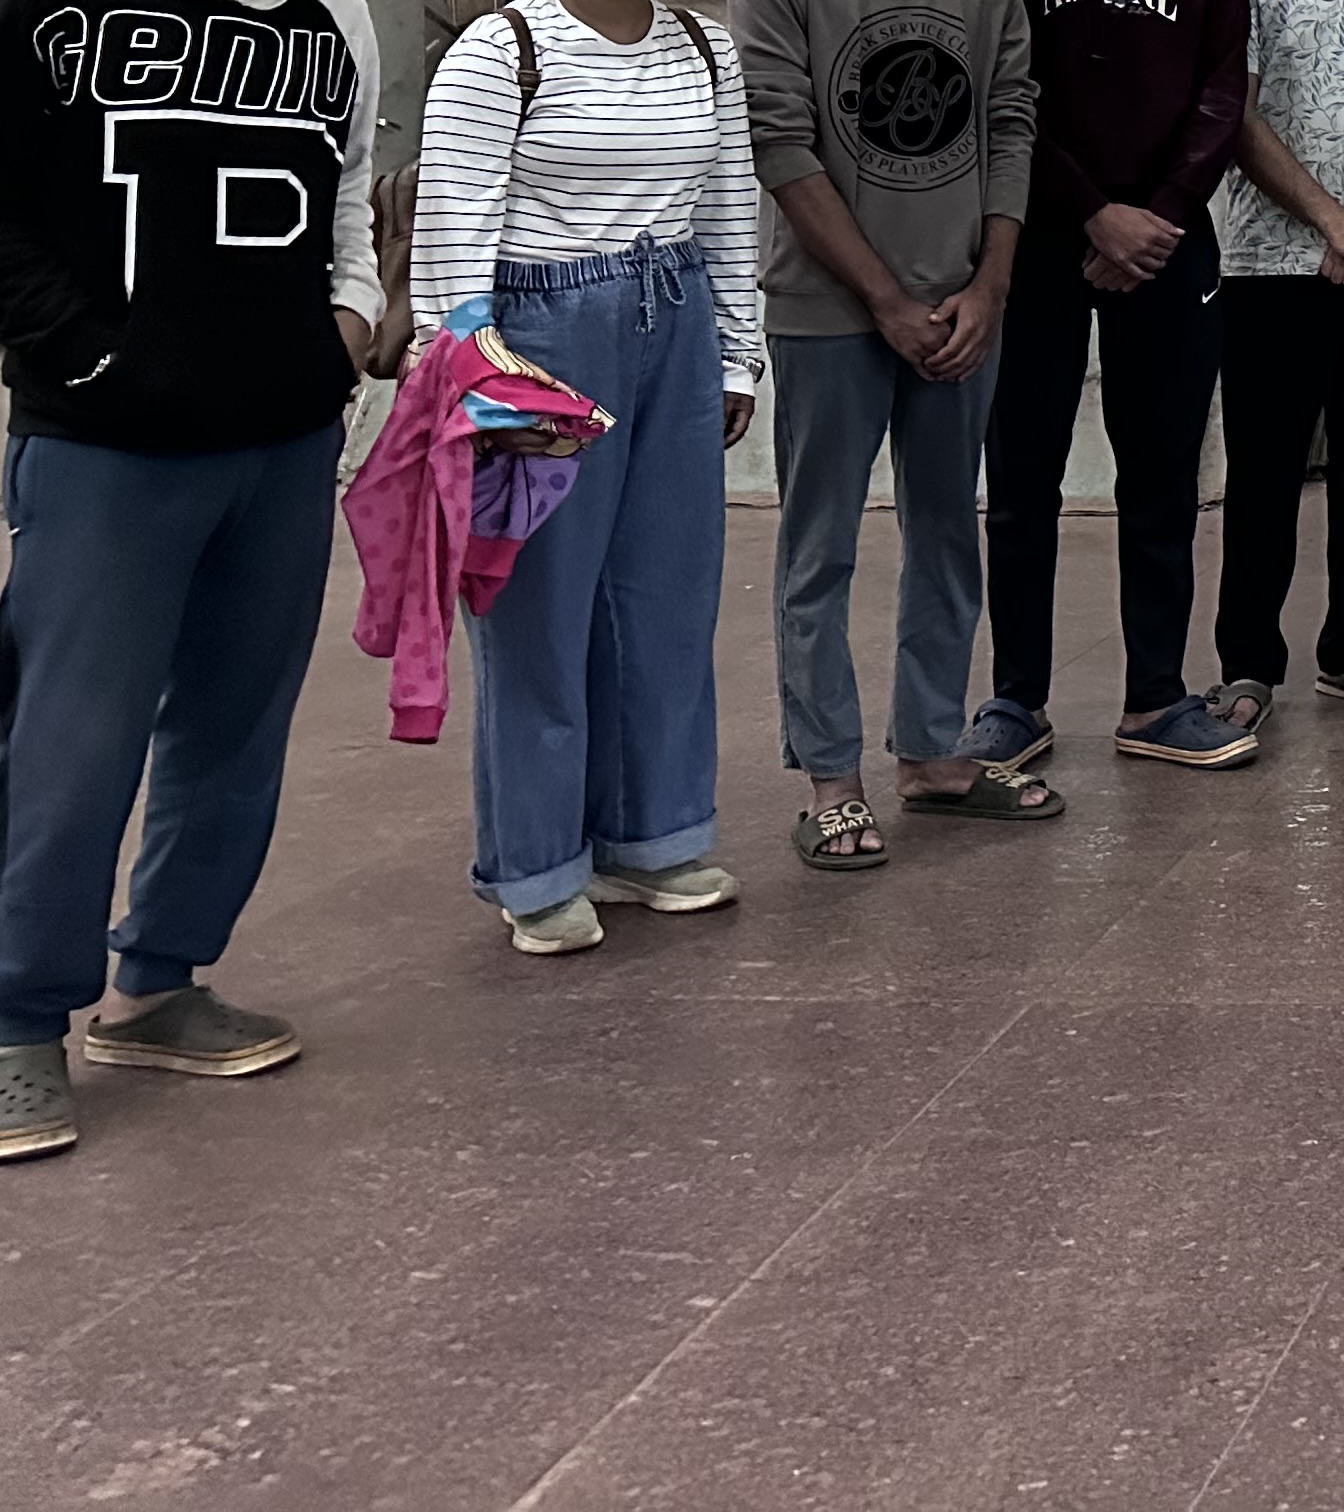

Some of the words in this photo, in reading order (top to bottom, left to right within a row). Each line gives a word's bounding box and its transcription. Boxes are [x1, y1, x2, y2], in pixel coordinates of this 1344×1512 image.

[879, 21, 947, 40] SERVICE
[877, 156, 949, 176] PLAYERS
[817, 800, 870, 829] SO
